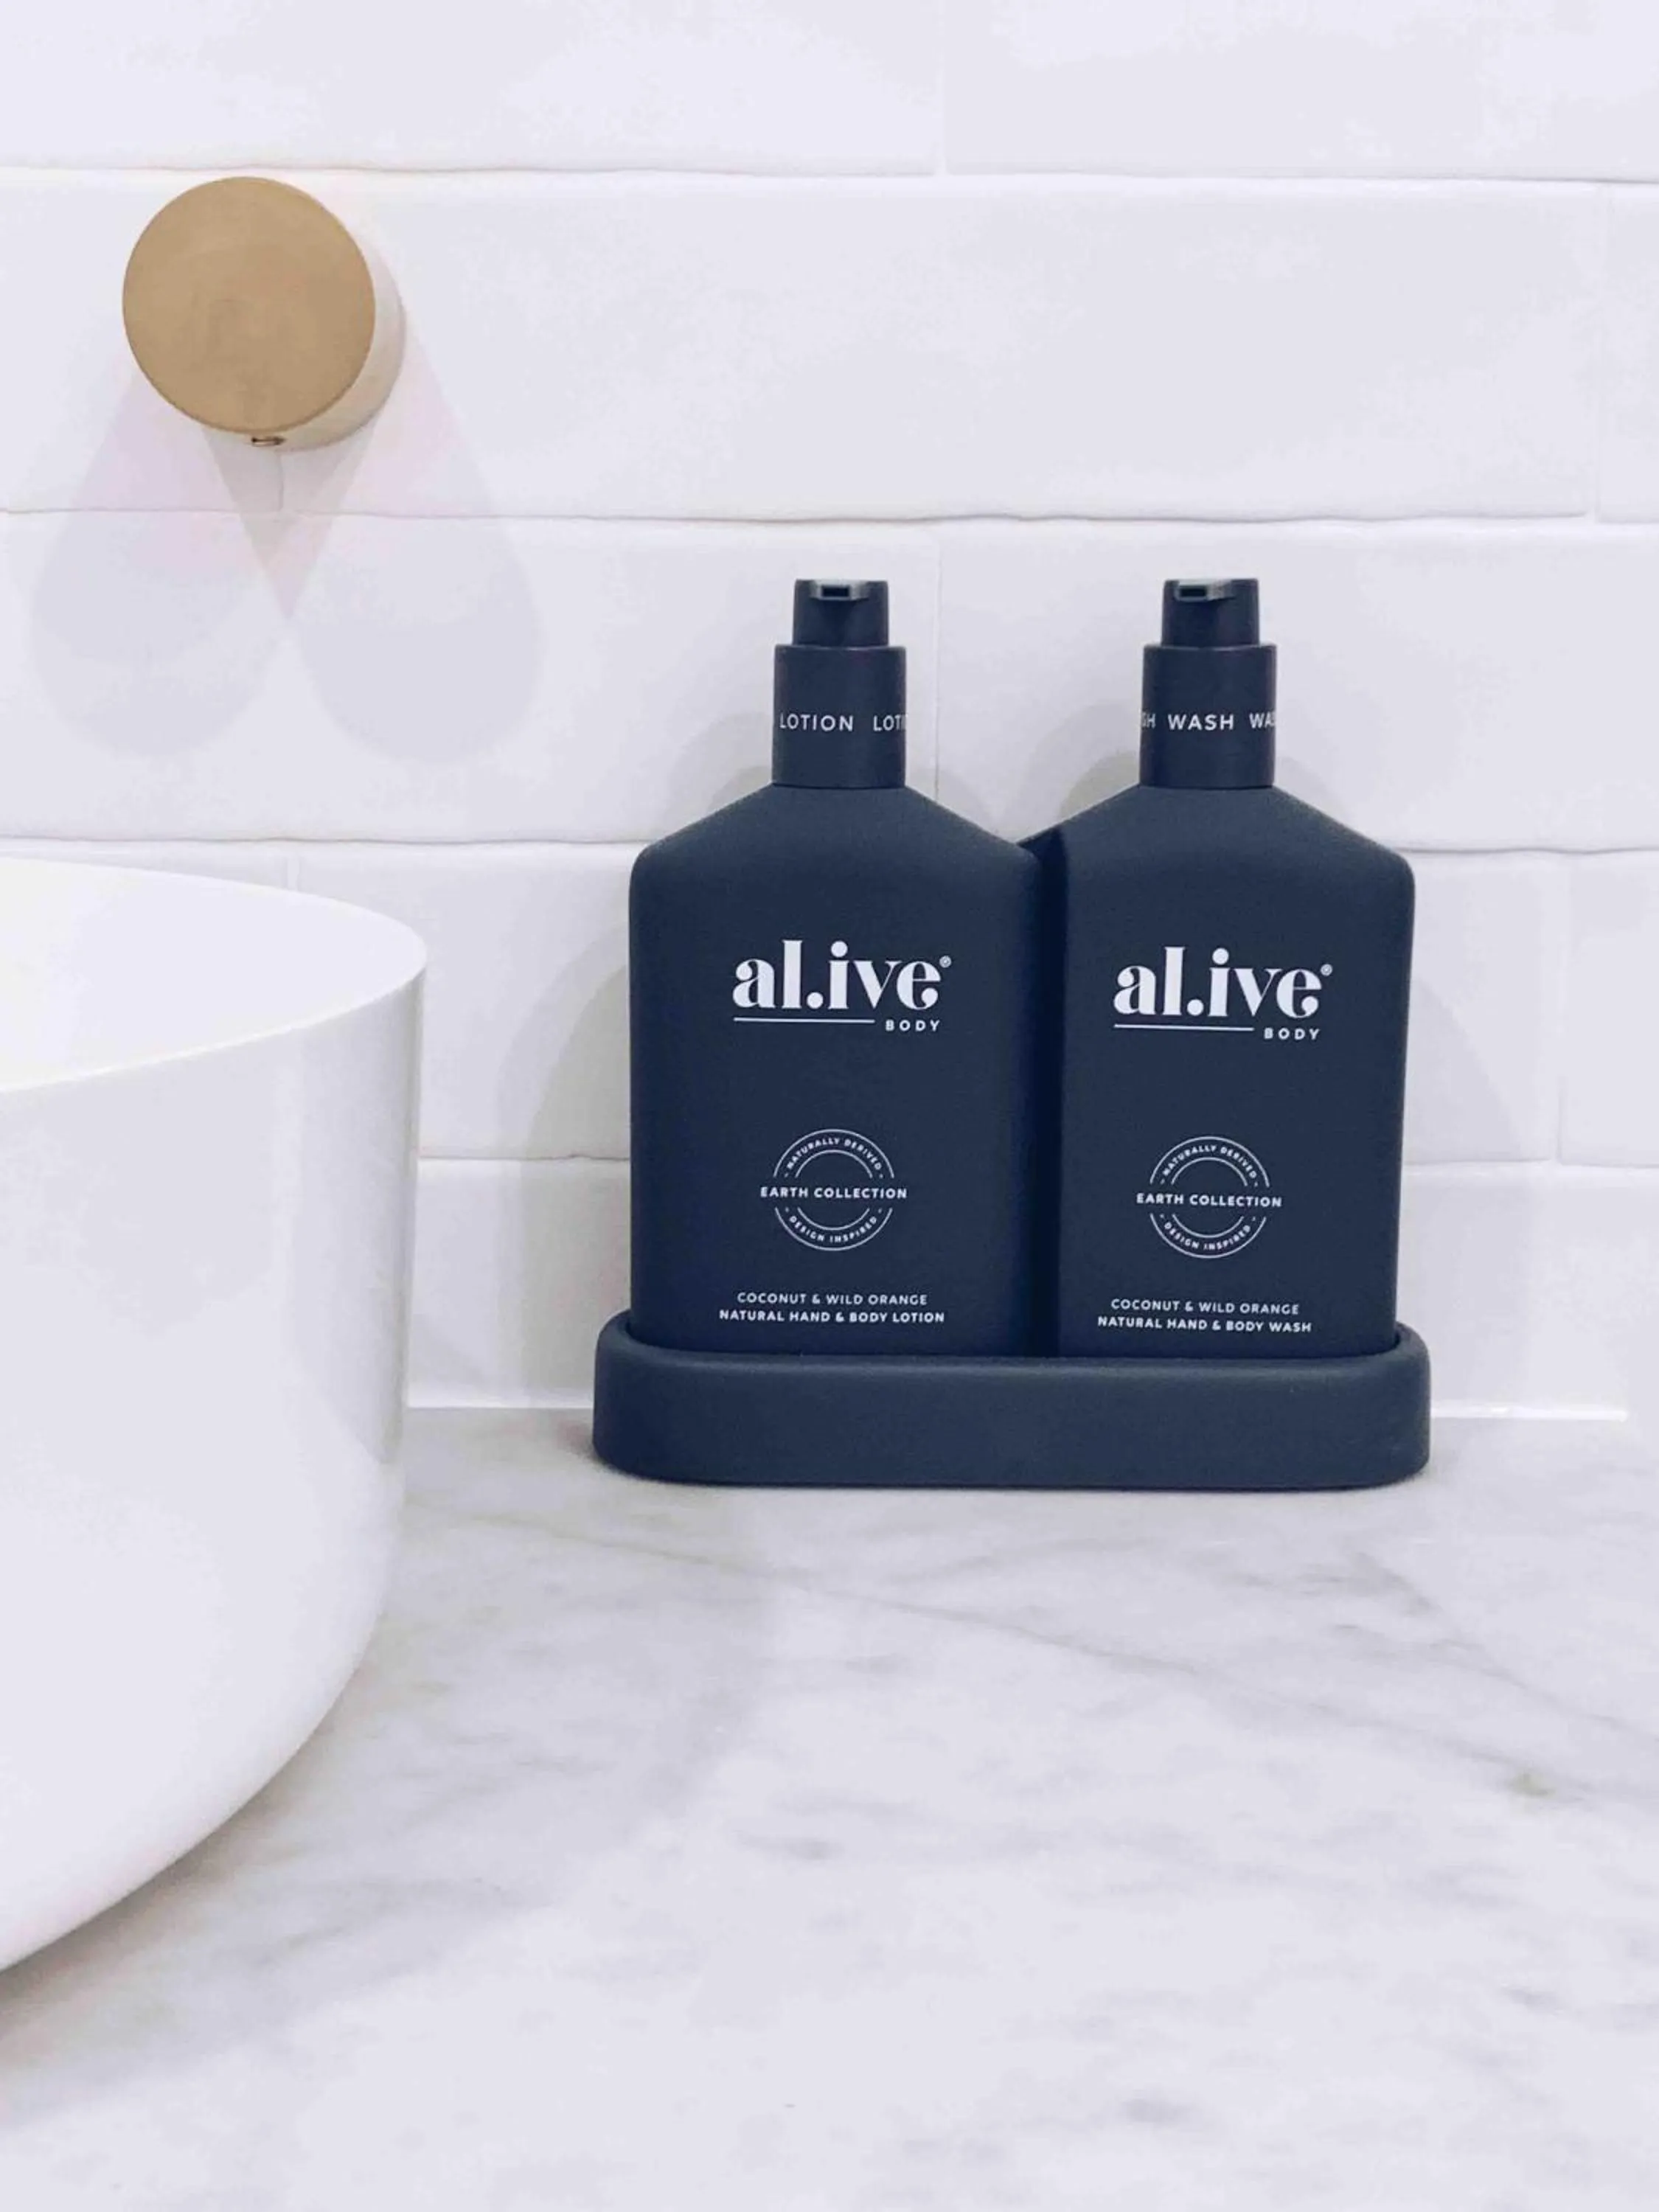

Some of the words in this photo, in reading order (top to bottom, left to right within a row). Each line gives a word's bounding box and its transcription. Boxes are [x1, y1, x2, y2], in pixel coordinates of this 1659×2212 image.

[779, 713, 853, 731] LOTION
[1167, 714, 1234, 731] WASH
[886, 1020, 940, 1032] BODY
[1264, 1028, 1319, 1040] BODY
[786, 1138, 841, 1169] NATURALLY
[844, 1139, 882, 1171] DERIVED
[1162, 1145, 1217, 1176] NATURALLY
[1220, 1147, 1257, 1178] DERIVED
[760, 1186, 808, 1197] EARTH
[814, 1188, 907, 1198] COLLECTION
[1136, 1192, 1184, 1204] EARTH
[1189, 1194, 1281, 1207] COLLECTION
[789, 1216, 825, 1242] DESIGN
[830, 1217, 877, 1243] INSPIRED
[1164, 1222, 1200, 1249] DESIGN
[1203, 1224, 1251, 1251] INSPIRED
[737, 1292, 807, 1304] COCONUT
[812, 1294, 821, 1304] &
[827, 1294, 863, 1304] WILD
[868, 1294, 927, 1305] ORANGE
[1111, 1298, 1180, 1311] COCONUT
[1185, 1301, 1194, 1312] &
[1198, 1301, 1235, 1313] WILD
[1239, 1303, 1298, 1315] ORANGE
[719, 1310, 785, 1322] NATURAL
[789, 1312, 830, 1322] HAND
[835, 1312, 844, 1322] &
[849, 1312, 888, 1323] BODY
[892, 1312, 945, 1323] LOTION
[1098, 1316, 1162, 1328] NATURAL
[1167, 1319, 1208, 1330] HAND
[1212, 1320, 1221, 1331] &
[1226, 1321, 1264, 1332] BODY
[1269, 1322, 1312, 1332] WASH
